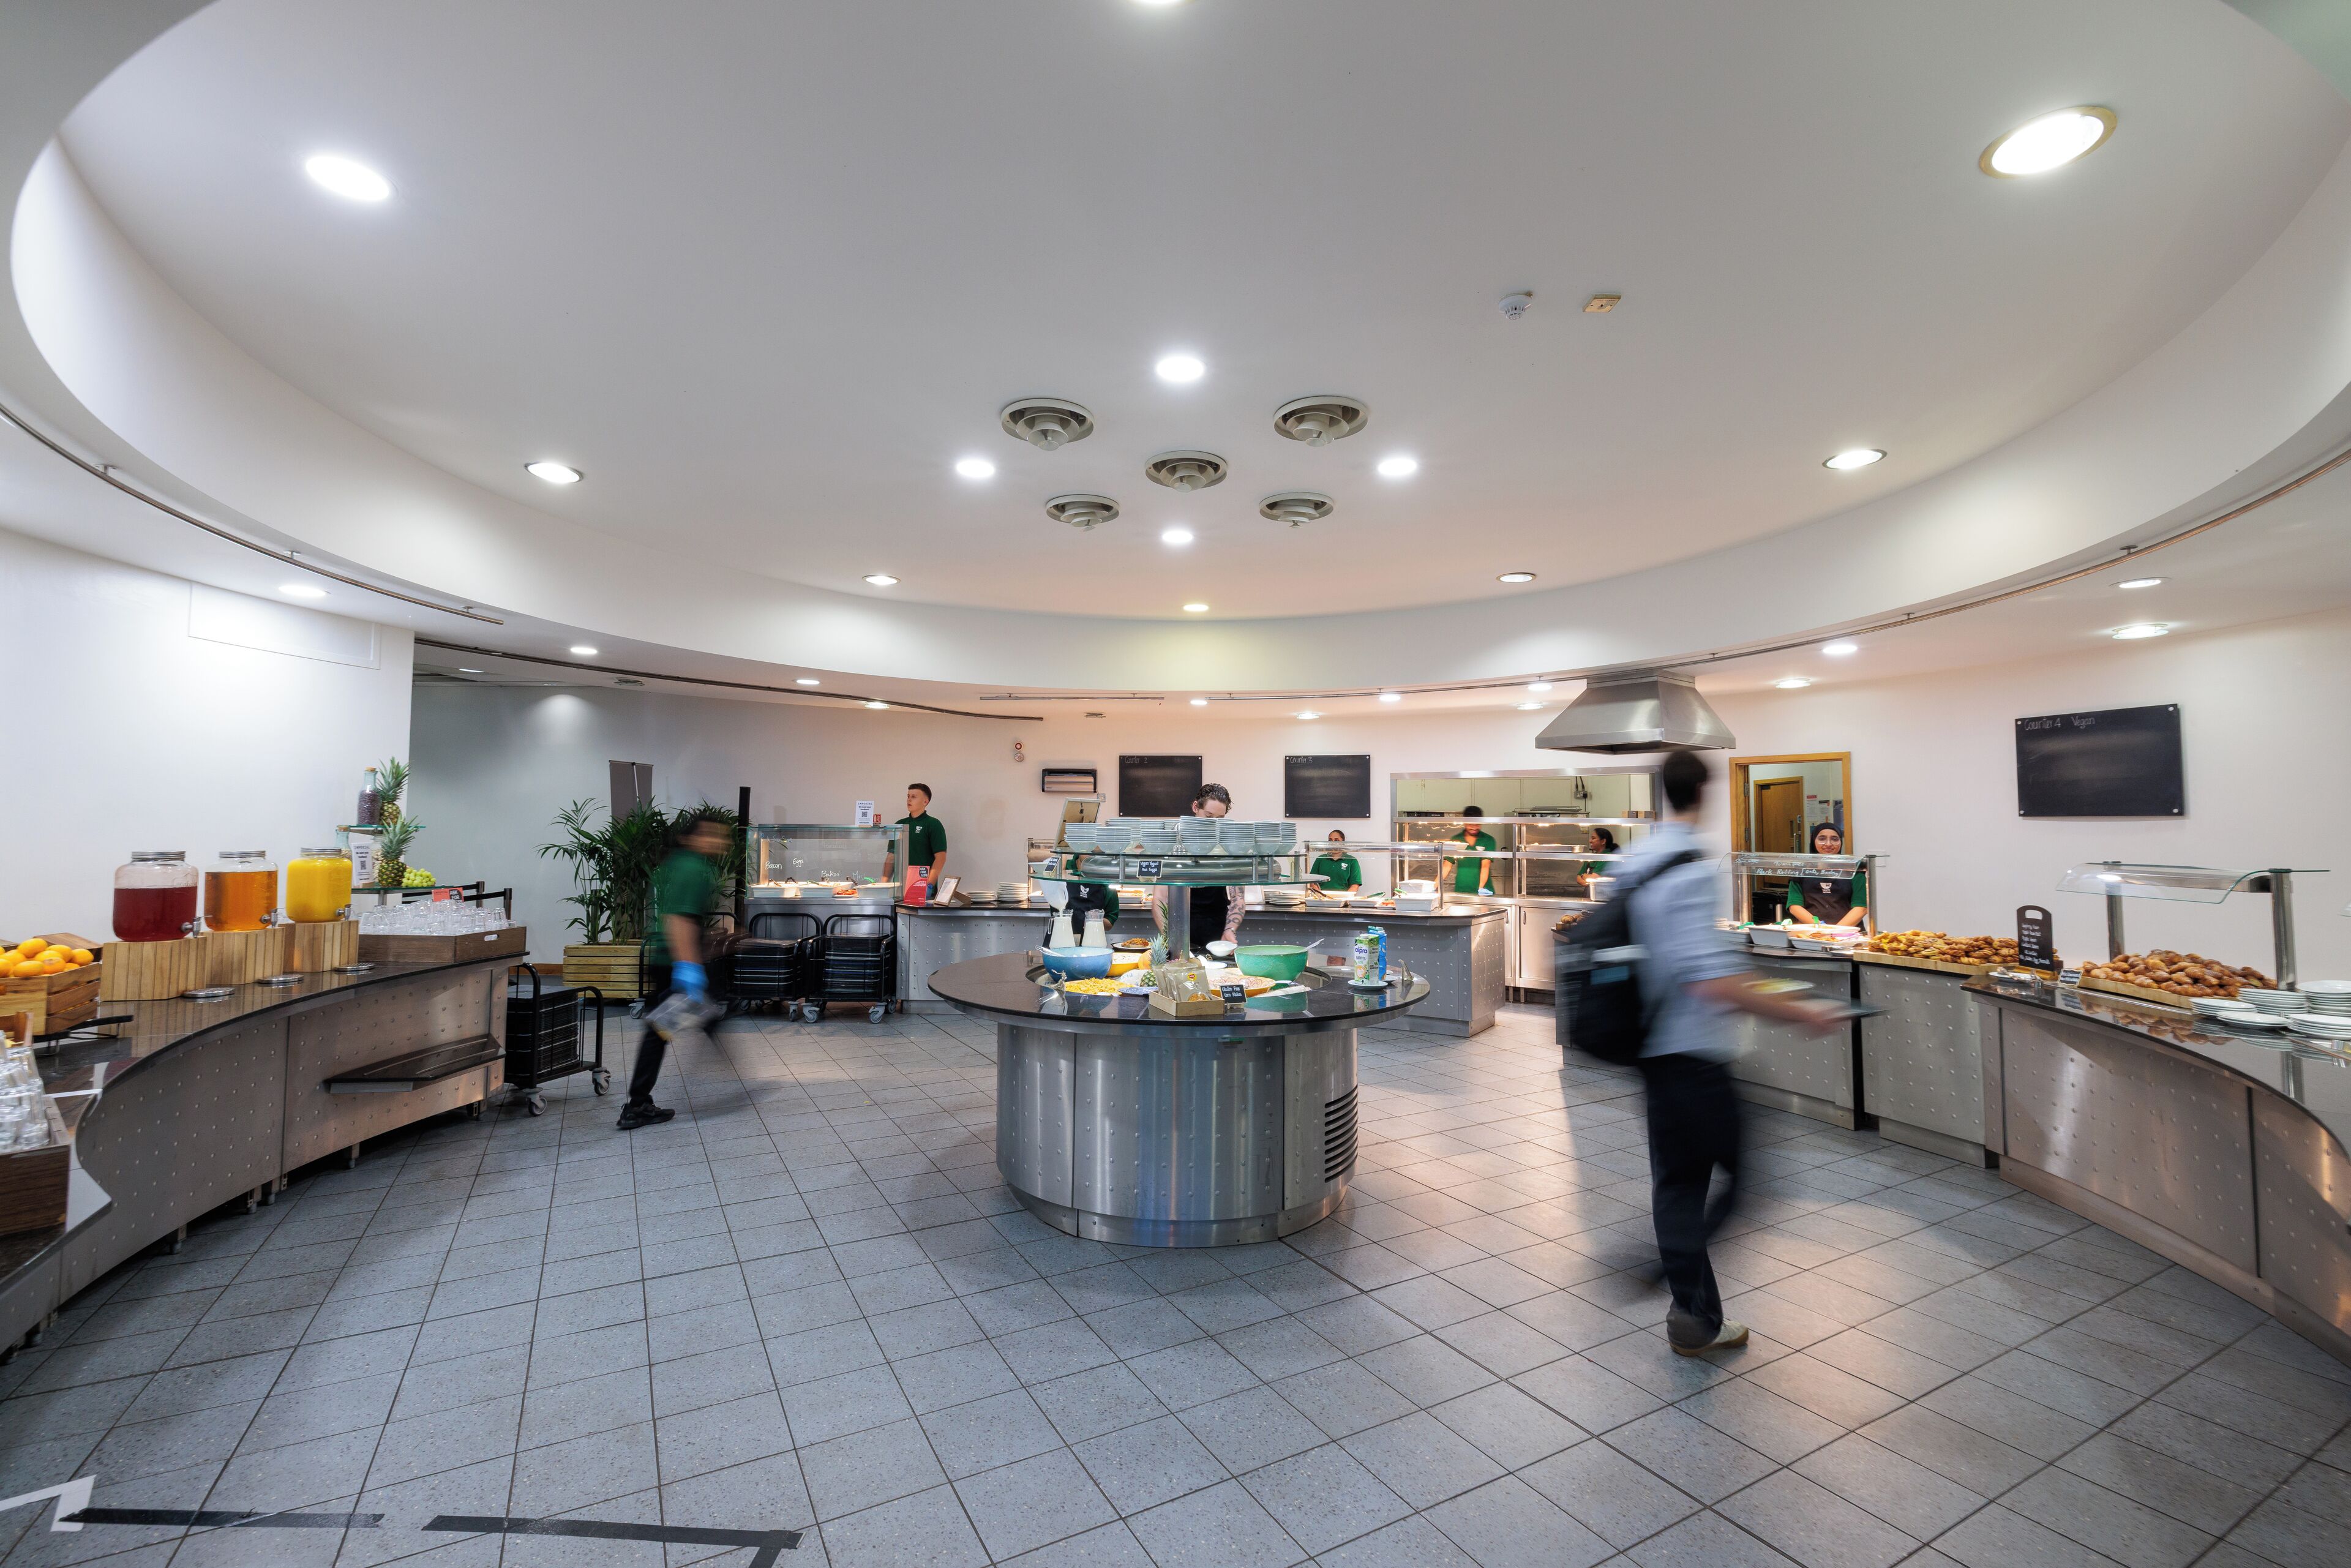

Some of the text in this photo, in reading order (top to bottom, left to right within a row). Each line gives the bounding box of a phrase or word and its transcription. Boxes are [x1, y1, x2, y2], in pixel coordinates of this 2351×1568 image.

[2054, 718, 2061, 727] 4
[2071, 716, 2095, 729] Vegan
[765, 861, 782, 869] Bacon
[793, 858, 803, 867] Eggs
